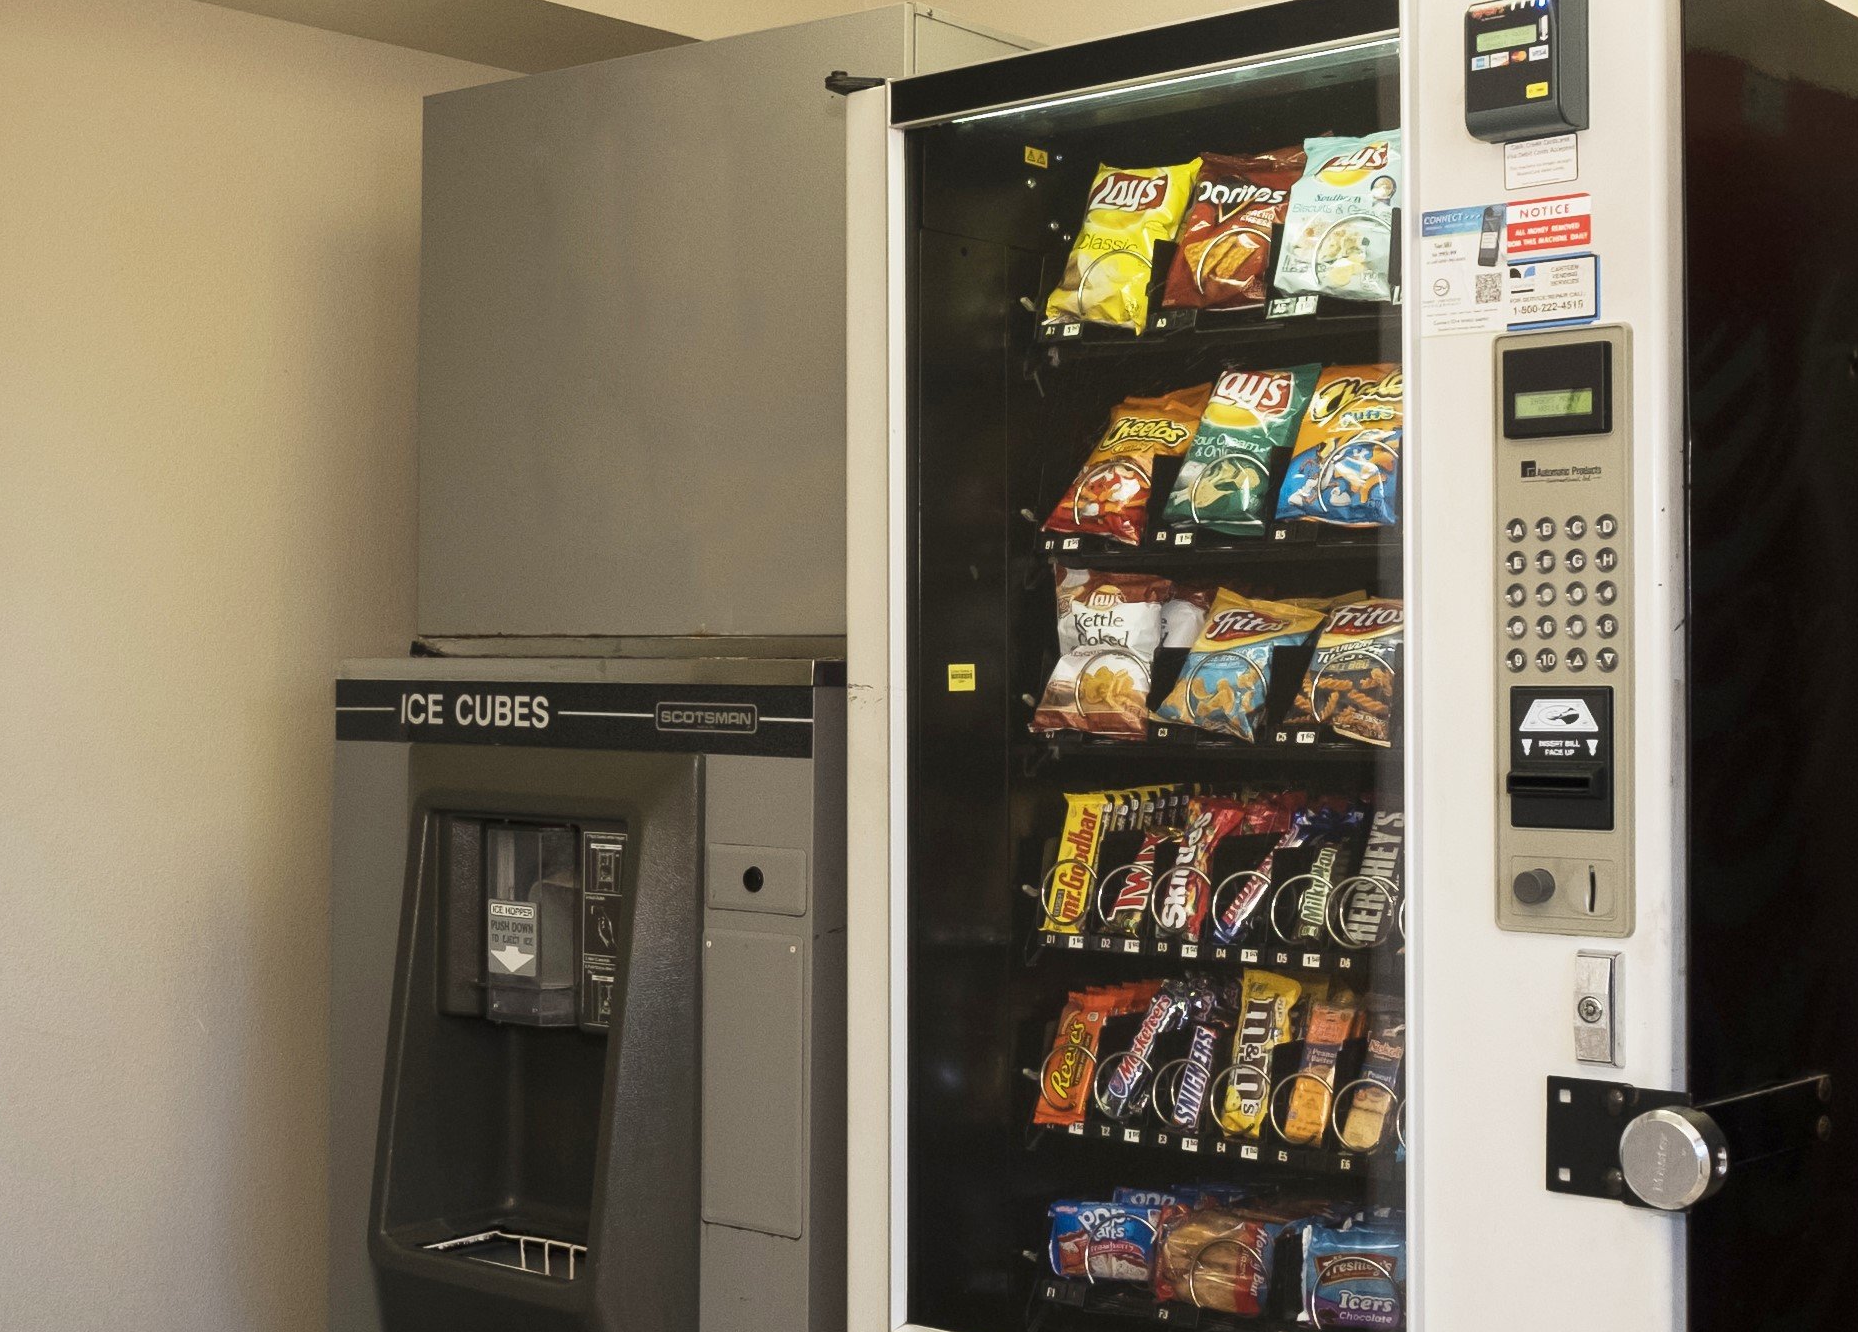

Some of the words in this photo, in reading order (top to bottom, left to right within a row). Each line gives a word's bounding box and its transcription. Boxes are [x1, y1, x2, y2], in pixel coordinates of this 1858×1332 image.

[1424, 212, 1464, 225] CONNECT
[1519, 203, 1570, 219] NOTICE
[1527, 226, 1549, 235] MONEY
[1551, 222, 1581, 233] REMOVED
[1077, 233, 1139, 251] Classic
[1507, 239, 1522, 247] ROM
[1524, 238, 1537, 246] THIS
[1539, 234, 1568, 244] MACHINE
[1571, 233, 1589, 242] DAILY
[1571, 466, 1602, 475] Products
[1513, 524, 1523, 537] A
[1543, 523, 1553, 536] B
[1572, 521, 1582, 534] C
[1602, 519, 1613, 532] D
[1572, 554, 1583, 567] G
[1603, 553, 1613, 566] H
[1074, 611, 1125, 635] Kettle
[1205, 609, 1291, 640] Fritos
[1604, 619, 1613, 632] 8
[1514, 654, 1523, 667] 9
[1541, 653, 1556, 667] 10
[400, 692, 444, 725] ICE
[455, 694, 550, 729] CUBES
[660, 709, 752, 726] SCOTSMAN
[1564, 739, 1581, 748] BILL
[492, 905, 504, 914] ICE
[491, 919, 510, 931] PUSH
[511, 922, 533, 934] DOWN
[1046, 934, 1056, 944] D1
[1101, 938, 1111, 948] D2
[1157, 942, 1168, 952] D3
[1046, 1287, 1056, 1298] F1
[1158, 1308, 1169, 1319] F3
[1338, 1289, 1395, 1313] Icers
[1339, 1310, 1393, 1324] Chocolate
